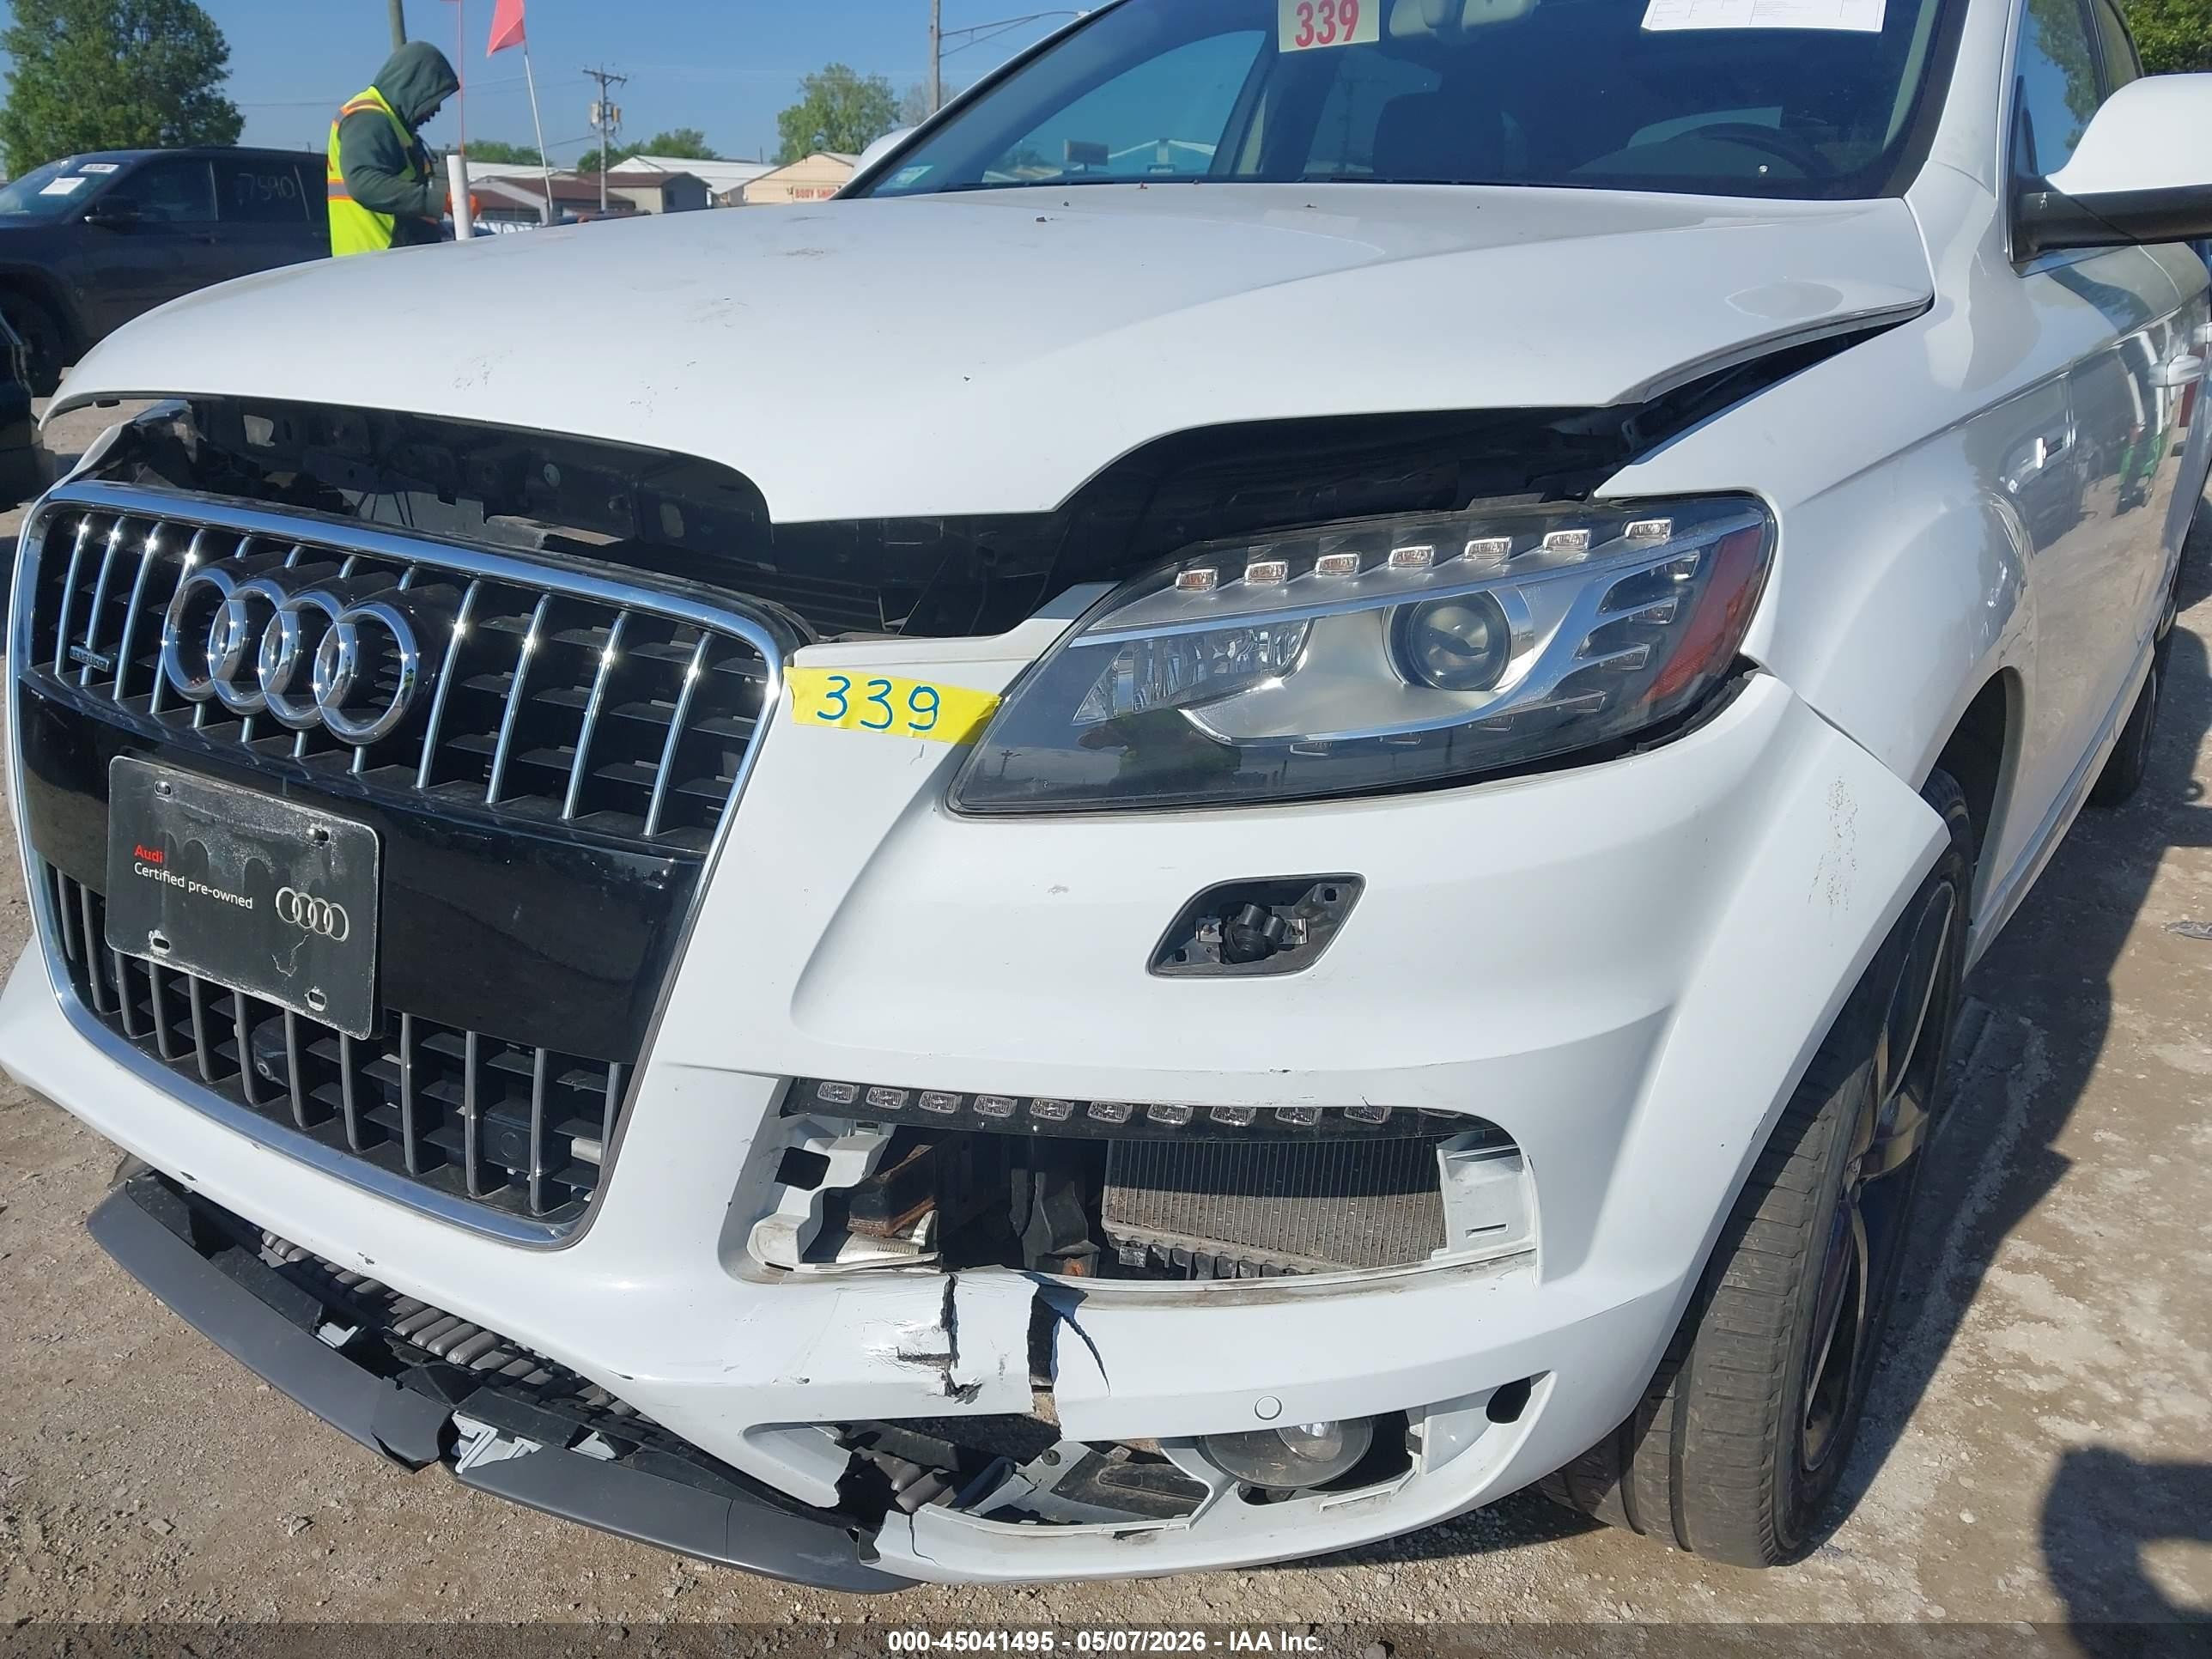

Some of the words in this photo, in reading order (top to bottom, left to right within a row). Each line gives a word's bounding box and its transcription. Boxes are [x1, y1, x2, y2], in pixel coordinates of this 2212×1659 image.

[1295, 0, 1359, 47] 339
[795, 188, 814, 199] BODY
[817, 675, 940, 731] 339
[134, 845, 163, 863] Audi
[134, 862, 185, 888] Certified
[188, 880, 252, 908] pre-owned
